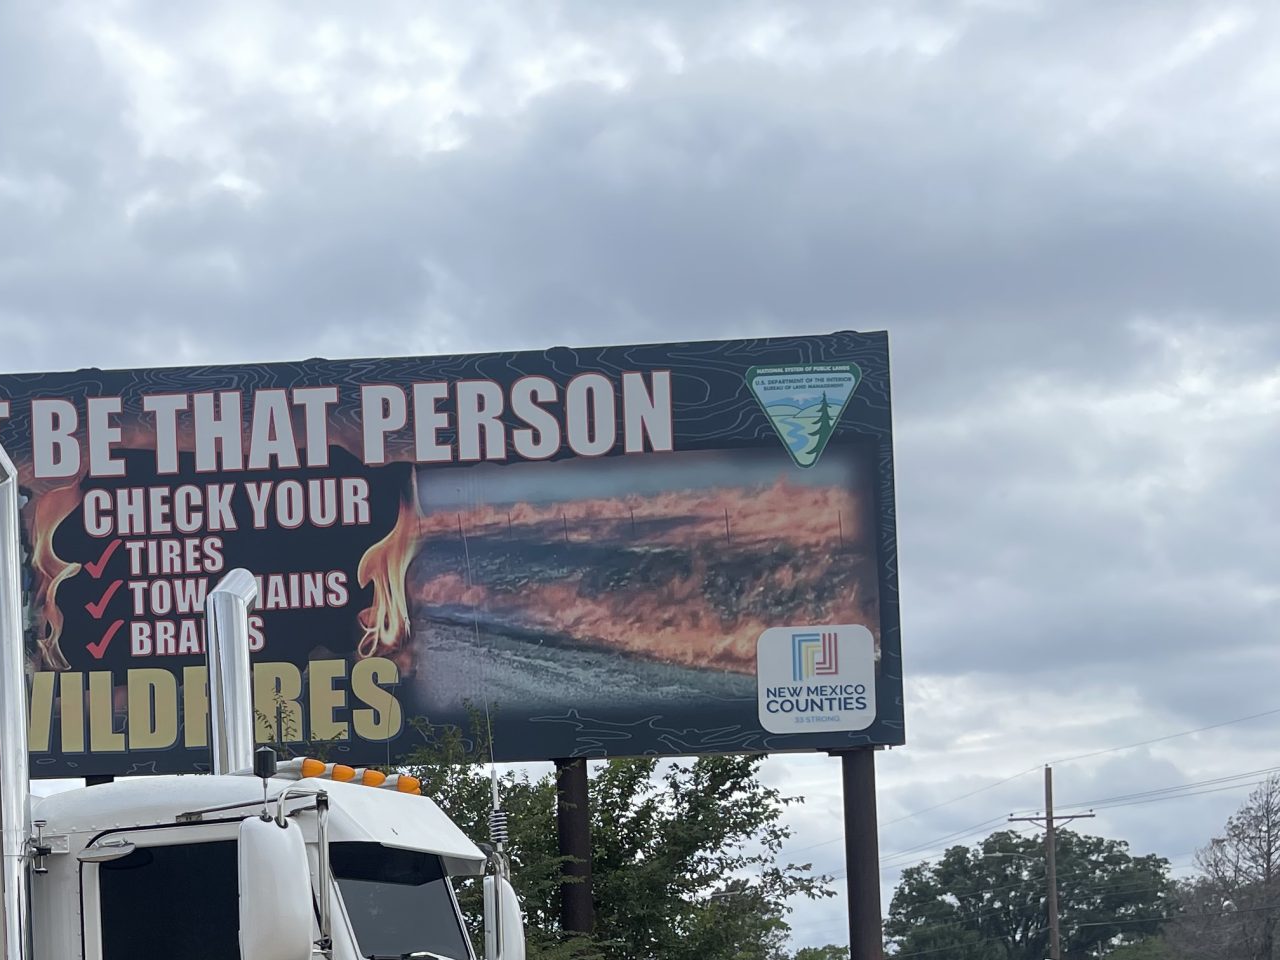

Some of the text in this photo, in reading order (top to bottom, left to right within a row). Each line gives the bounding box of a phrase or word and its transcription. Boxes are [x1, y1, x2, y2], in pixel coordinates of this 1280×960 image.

[30, 396, 128, 479] BE
[142, 385, 340, 475] THAT
[359, 369, 674, 467] PERSON
[83, 478, 371, 537] CHECK YOUR
[125, 536, 224, 576] TIRES
[128, 570, 349, 616] TOW AINS
[130, 615, 265, 657] BRAS
[26, 656, 404, 754] ILDFRES
[766, 684, 866, 698] NEW MEXICO
[766, 696, 867, 714] COUNTIES
